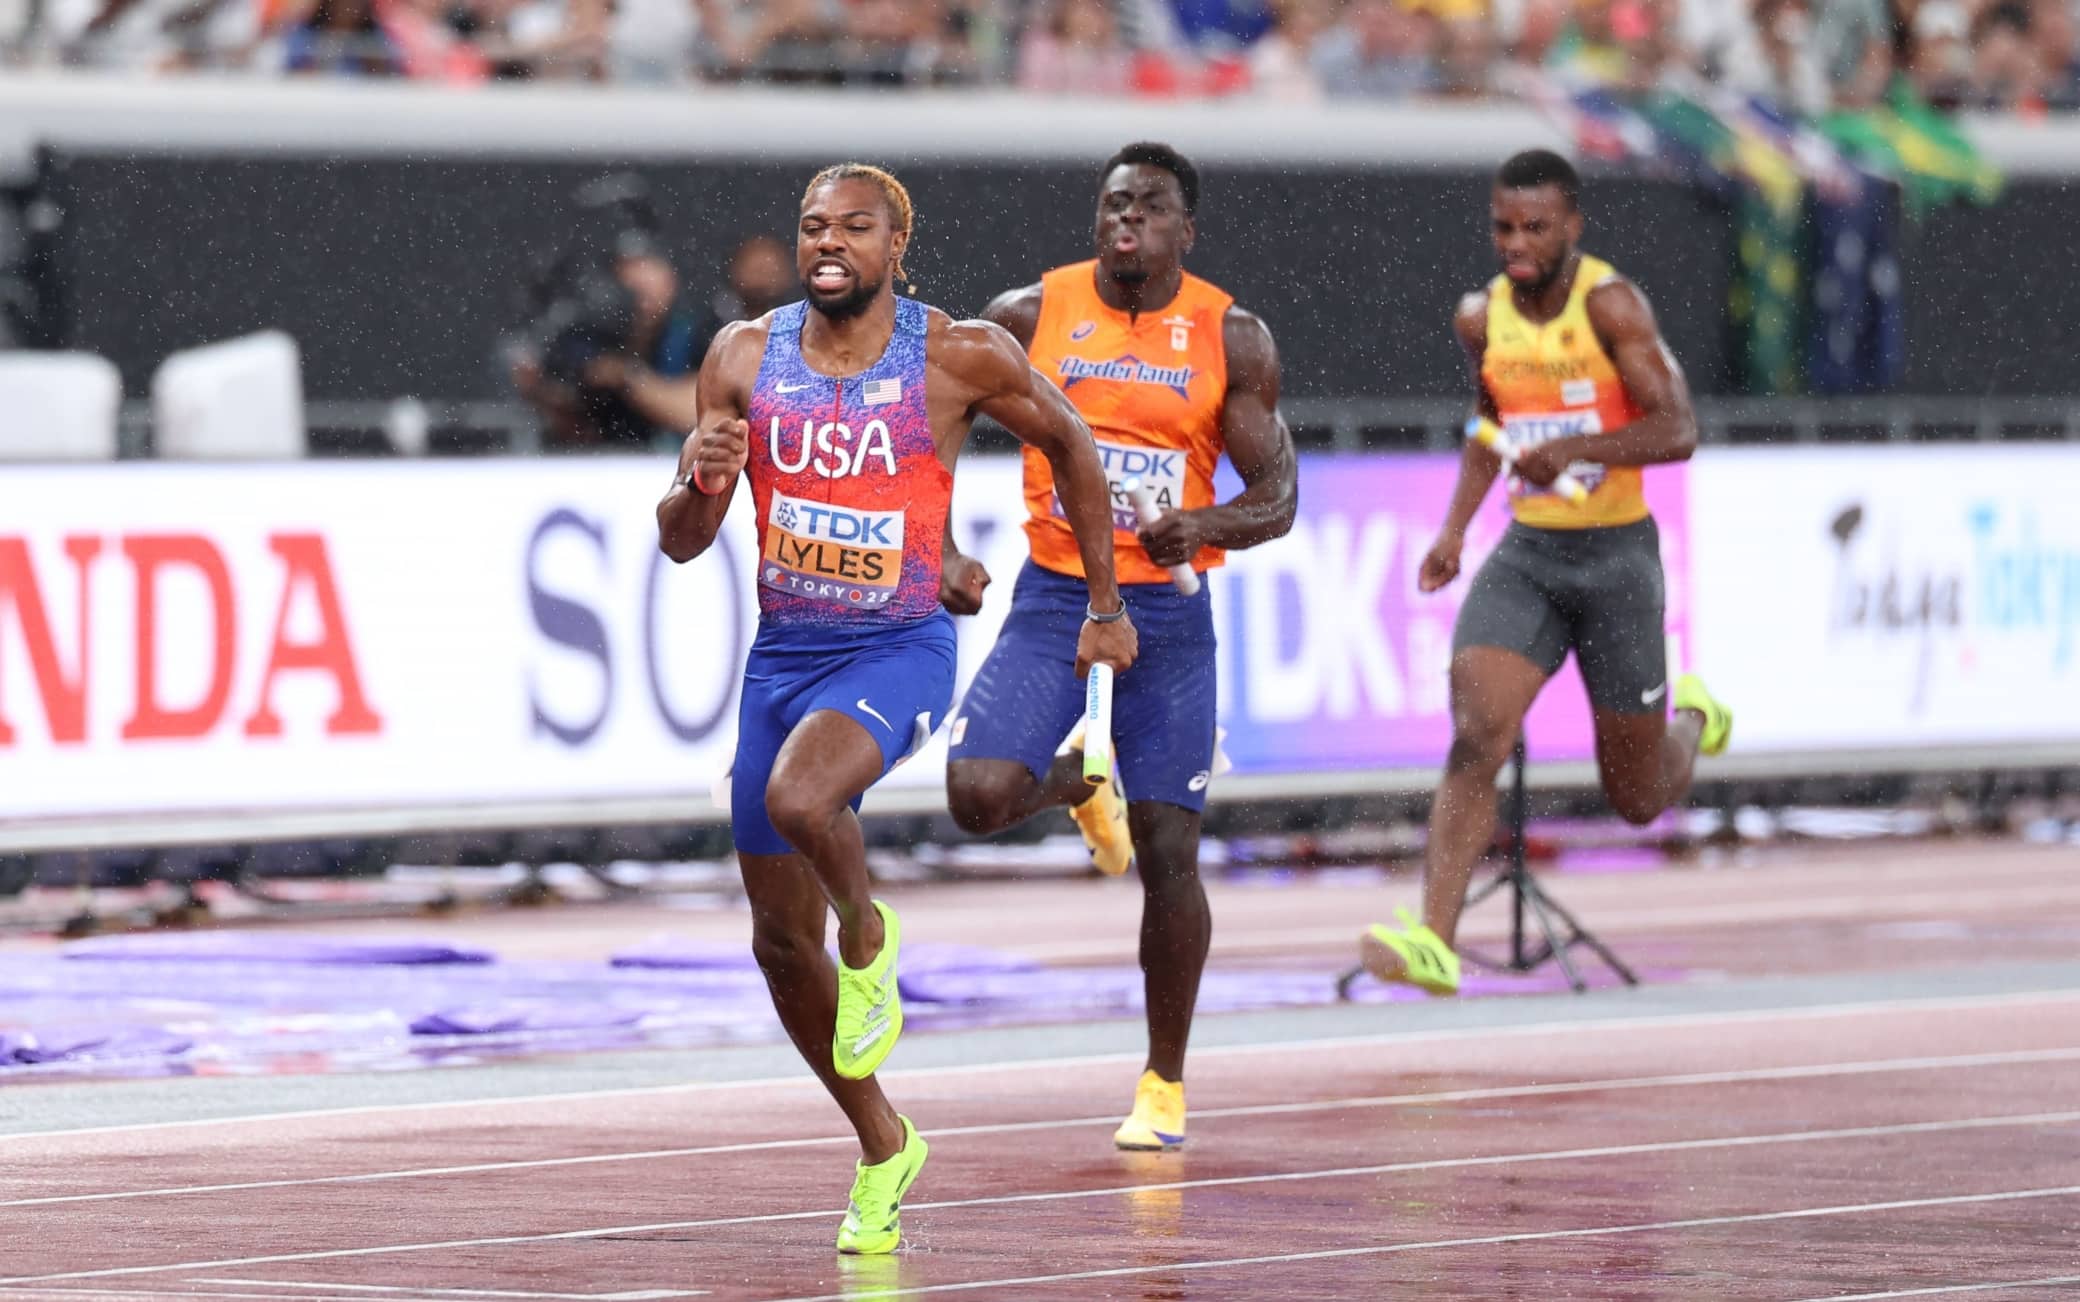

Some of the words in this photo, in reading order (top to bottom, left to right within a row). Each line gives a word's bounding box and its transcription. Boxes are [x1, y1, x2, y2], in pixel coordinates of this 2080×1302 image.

[1059, 357, 1190, 386] Nederland
[770, 416, 897, 477] USA
[1097, 445, 1175, 477] TDK
[800, 505, 893, 544] TDK
[777, 534, 883, 580] LYLES
